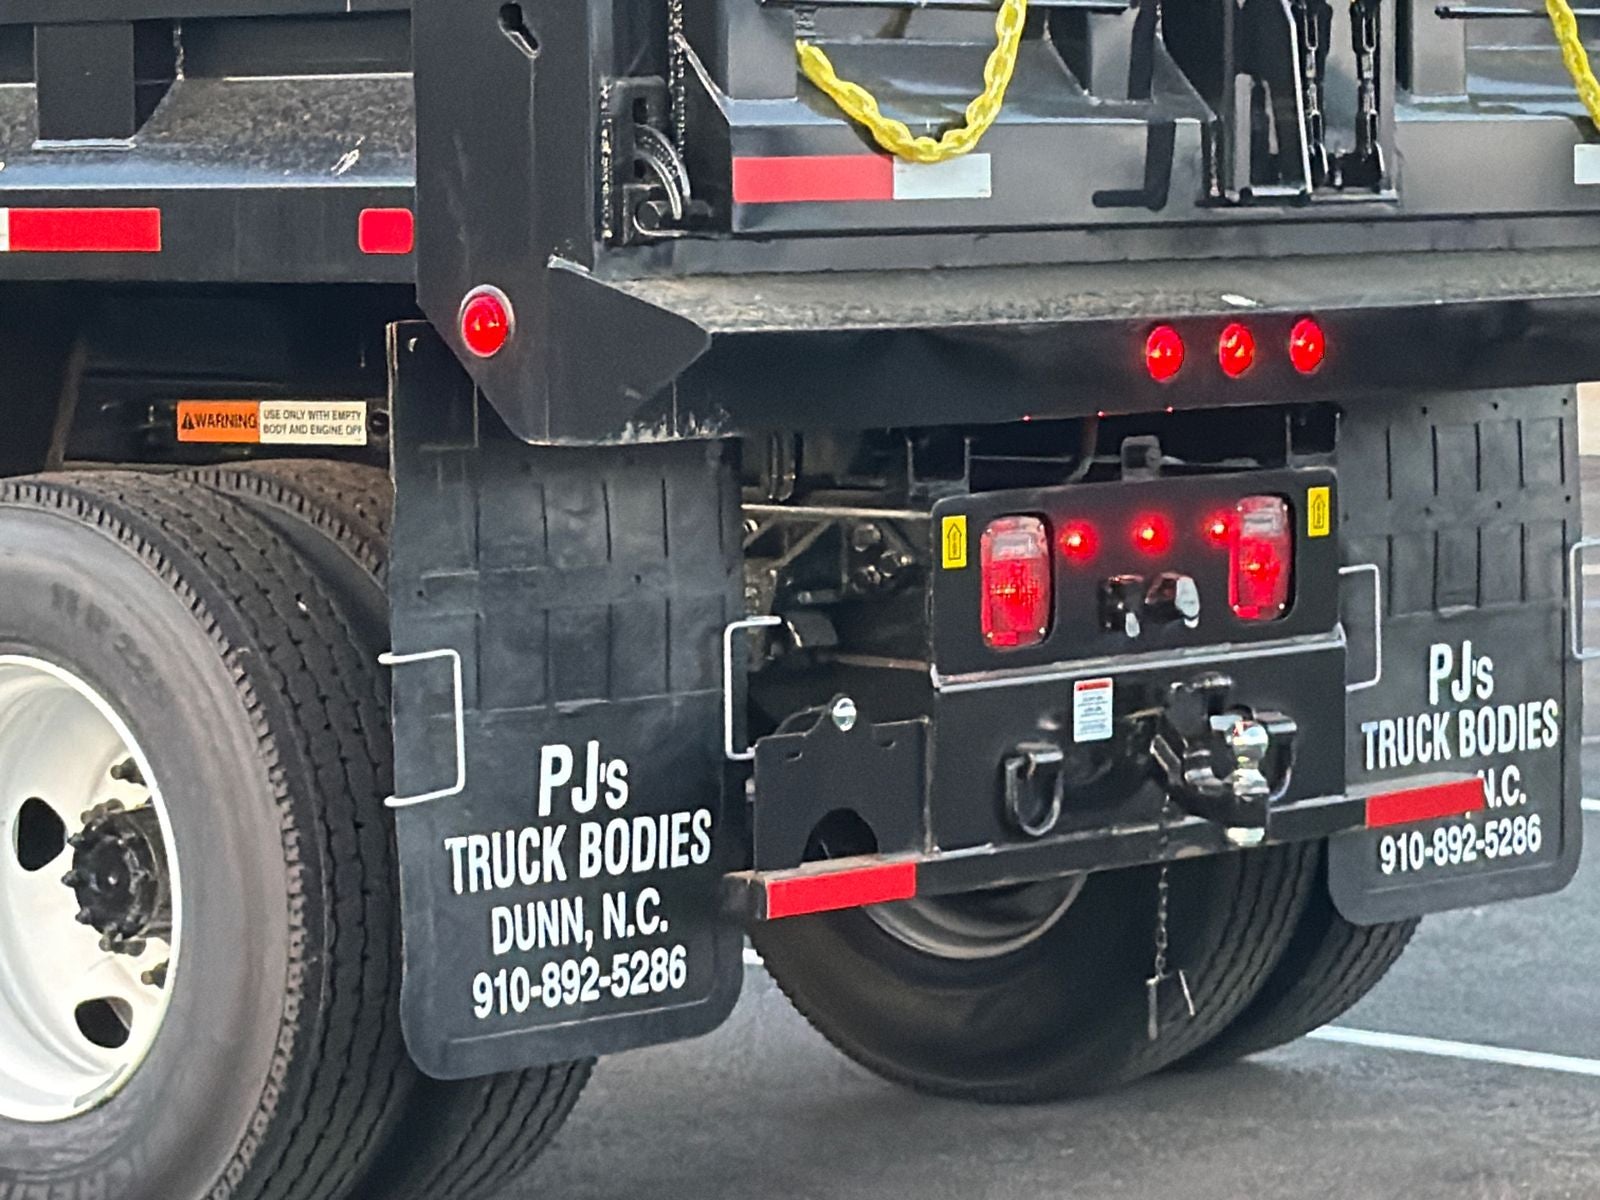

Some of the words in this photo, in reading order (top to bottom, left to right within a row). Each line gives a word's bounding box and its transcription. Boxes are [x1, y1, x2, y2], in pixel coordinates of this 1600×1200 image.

[194, 413, 258, 429] WARNING
[263, 409, 281, 420] USE
[283, 409, 306, 420] ONLY
[308, 410, 330, 420] WITH
[332, 410, 361, 420] EMPTY
[263, 423, 286, 434] BODY
[289, 424, 308, 434] AND
[310, 424, 343, 435] ENGINE
[1429, 640, 1494, 705] PJ's
[1361, 711, 1451, 770] TRUCK
[1458, 698, 1559, 758] BODIES
[538, 740, 629, 817] PJ's
[444, 824, 567, 894] TRUCK
[579, 808, 712, 879] BODIES
[1380, 813, 1542, 875] 910-892-5286
[491, 896, 594, 955] DUNN,
[602, 887, 669, 940] N.C.
[472, 944, 687, 1019] 910-892-5286
